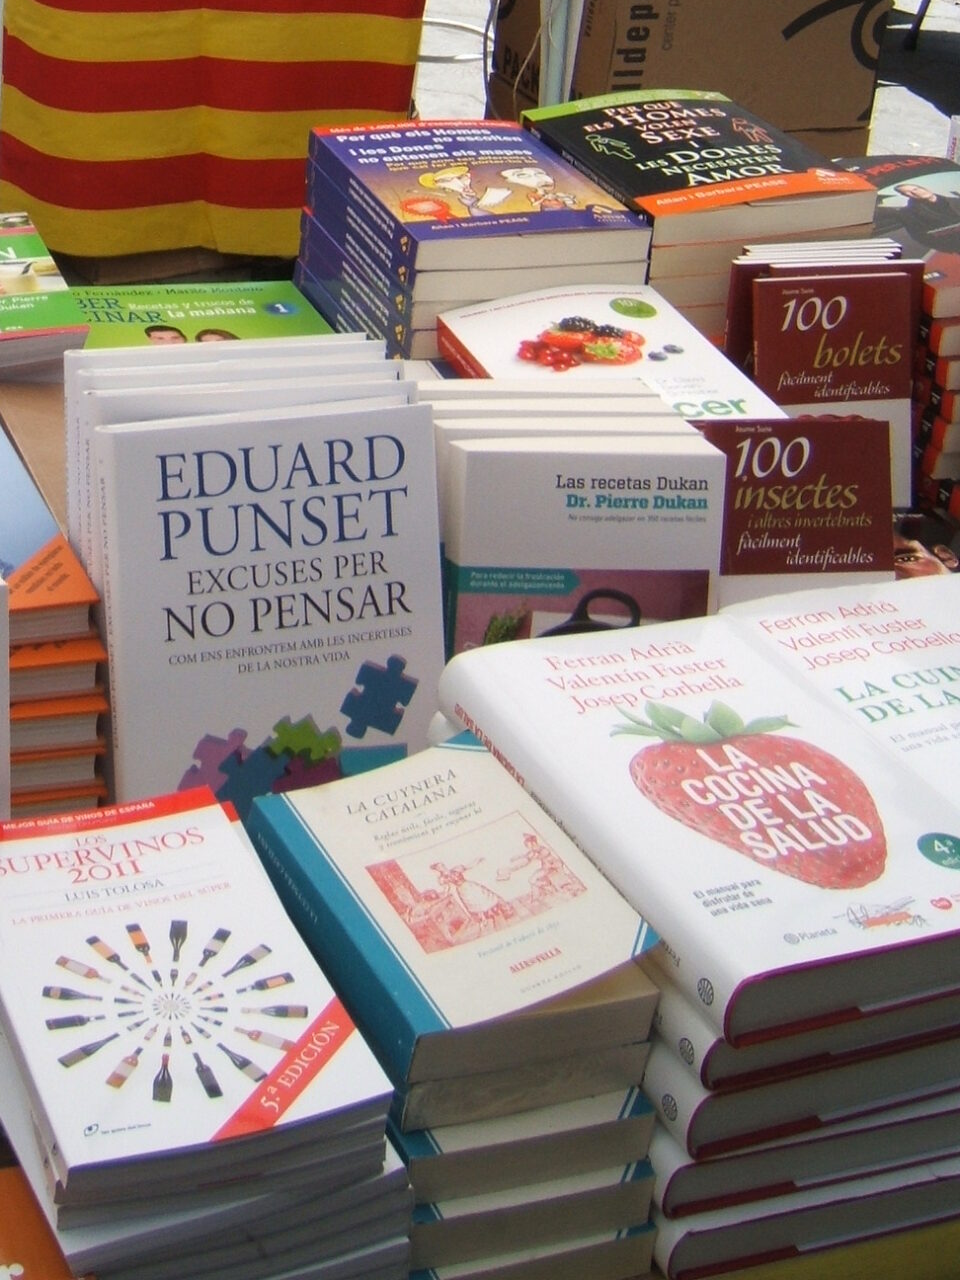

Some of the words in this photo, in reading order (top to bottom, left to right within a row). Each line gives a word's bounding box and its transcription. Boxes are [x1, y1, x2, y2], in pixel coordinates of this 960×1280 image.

[584, 122, 614, 133] ELS
[616, 108, 726, 126] HOMES
[604, 103, 641, 117] PER
[643, 101, 682, 110] QUE
[336, 133, 366, 143] Per
[406, 129, 430, 138] els
[432, 128, 491, 137] Homes
[456, 135, 522, 143] escolten
[636, 120, 697, 132] VOLEN
[640, 126, 721, 144] SEXE
[359, 156, 379, 164] no
[383, 152, 449, 162] entenen
[452, 150, 477, 158] els
[479, 148, 533, 157] mapes
[361, 146, 386, 155] les
[389, 143, 444, 154] Dones
[638, 160, 668, 170] LES
[670, 144, 783, 164] DONES
[663, 156, 781, 177] NECESSITEN
[687, 164, 794, 187] AMOR
[188, 306, 257, 317] mañana
[781, 296, 847, 332] 100
[813, 331, 903, 368] bolets
[814, 381, 890, 401] identificables
[156, 434, 405, 502] EDUARD
[735, 437, 810, 478] 100
[556, 475, 585, 489] Las
[590, 477, 651, 490] recetas
[657, 476, 709, 491] Dukan
[734, 473, 859, 510] insectes
[566, 494, 590, 508] Dr.
[595, 495, 649, 509] Pierre
[653, 496, 708, 509] Dukan
[157, 485, 408, 561] PUNSET
[794, 510, 873, 528] invertebrats
[737, 531, 801, 555] fàcilment
[786, 547, 874, 570] identificables
[187, 558, 323, 596] EXCUSES
[334, 551, 388, 579] PER
[162, 601, 235, 643] NO
[250, 580, 413, 633] PENSAR
[759, 608, 834, 635] Ferran
[838, 600, 899, 619] Adrià
[860, 615, 928, 637] Fuster
[168, 654, 197, 666] COM
[201, 650, 222, 663] ENS
[225, 641, 297, 660] ENFRONTEM
[300, 637, 324, 651] AMB
[326, 634, 345, 647] LES
[347, 626, 413, 645] INCERTESES
[545, 650, 625, 673] Ferran
[631, 641, 695, 663] Adrià
[805, 641, 871, 672] Josep
[238, 663, 252, 674] DE
[256, 659, 272, 672] LA
[274, 654, 320, 671] NOSTRA
[323, 651, 351, 664] VIDA
[546, 667, 652, 693] Valentín
[658, 656, 728, 680] Fuster
[570, 684, 639, 716] Josep
[641, 674, 744, 701] Corbella
[835, 680, 889, 702] LA
[858, 698, 914, 723] DE
[913, 690, 960, 709] LA
[696, 744, 758, 773] LA
[346, 803, 368, 816] LA
[373, 769, 458, 808] CUYNERA
[680, 762, 827, 805] COCINA
[365, 784, 458, 825] CATALANA
[718, 798, 783, 831] DE
[778, 790, 842, 820] LA
[3, 819, 36, 830] MEJOR
[76, 810, 103, 822] VINOS
[106, 808, 117, 817] DE
[74, 833, 108, 848] LOS
[739, 814, 873, 860] SALUD
[68, 858, 143, 885] 2011
[65, 887, 101, 903] LUIS
[103, 879, 164, 897] TOLOSA
[279, 1020, 341, 1089] EDICIÓN
